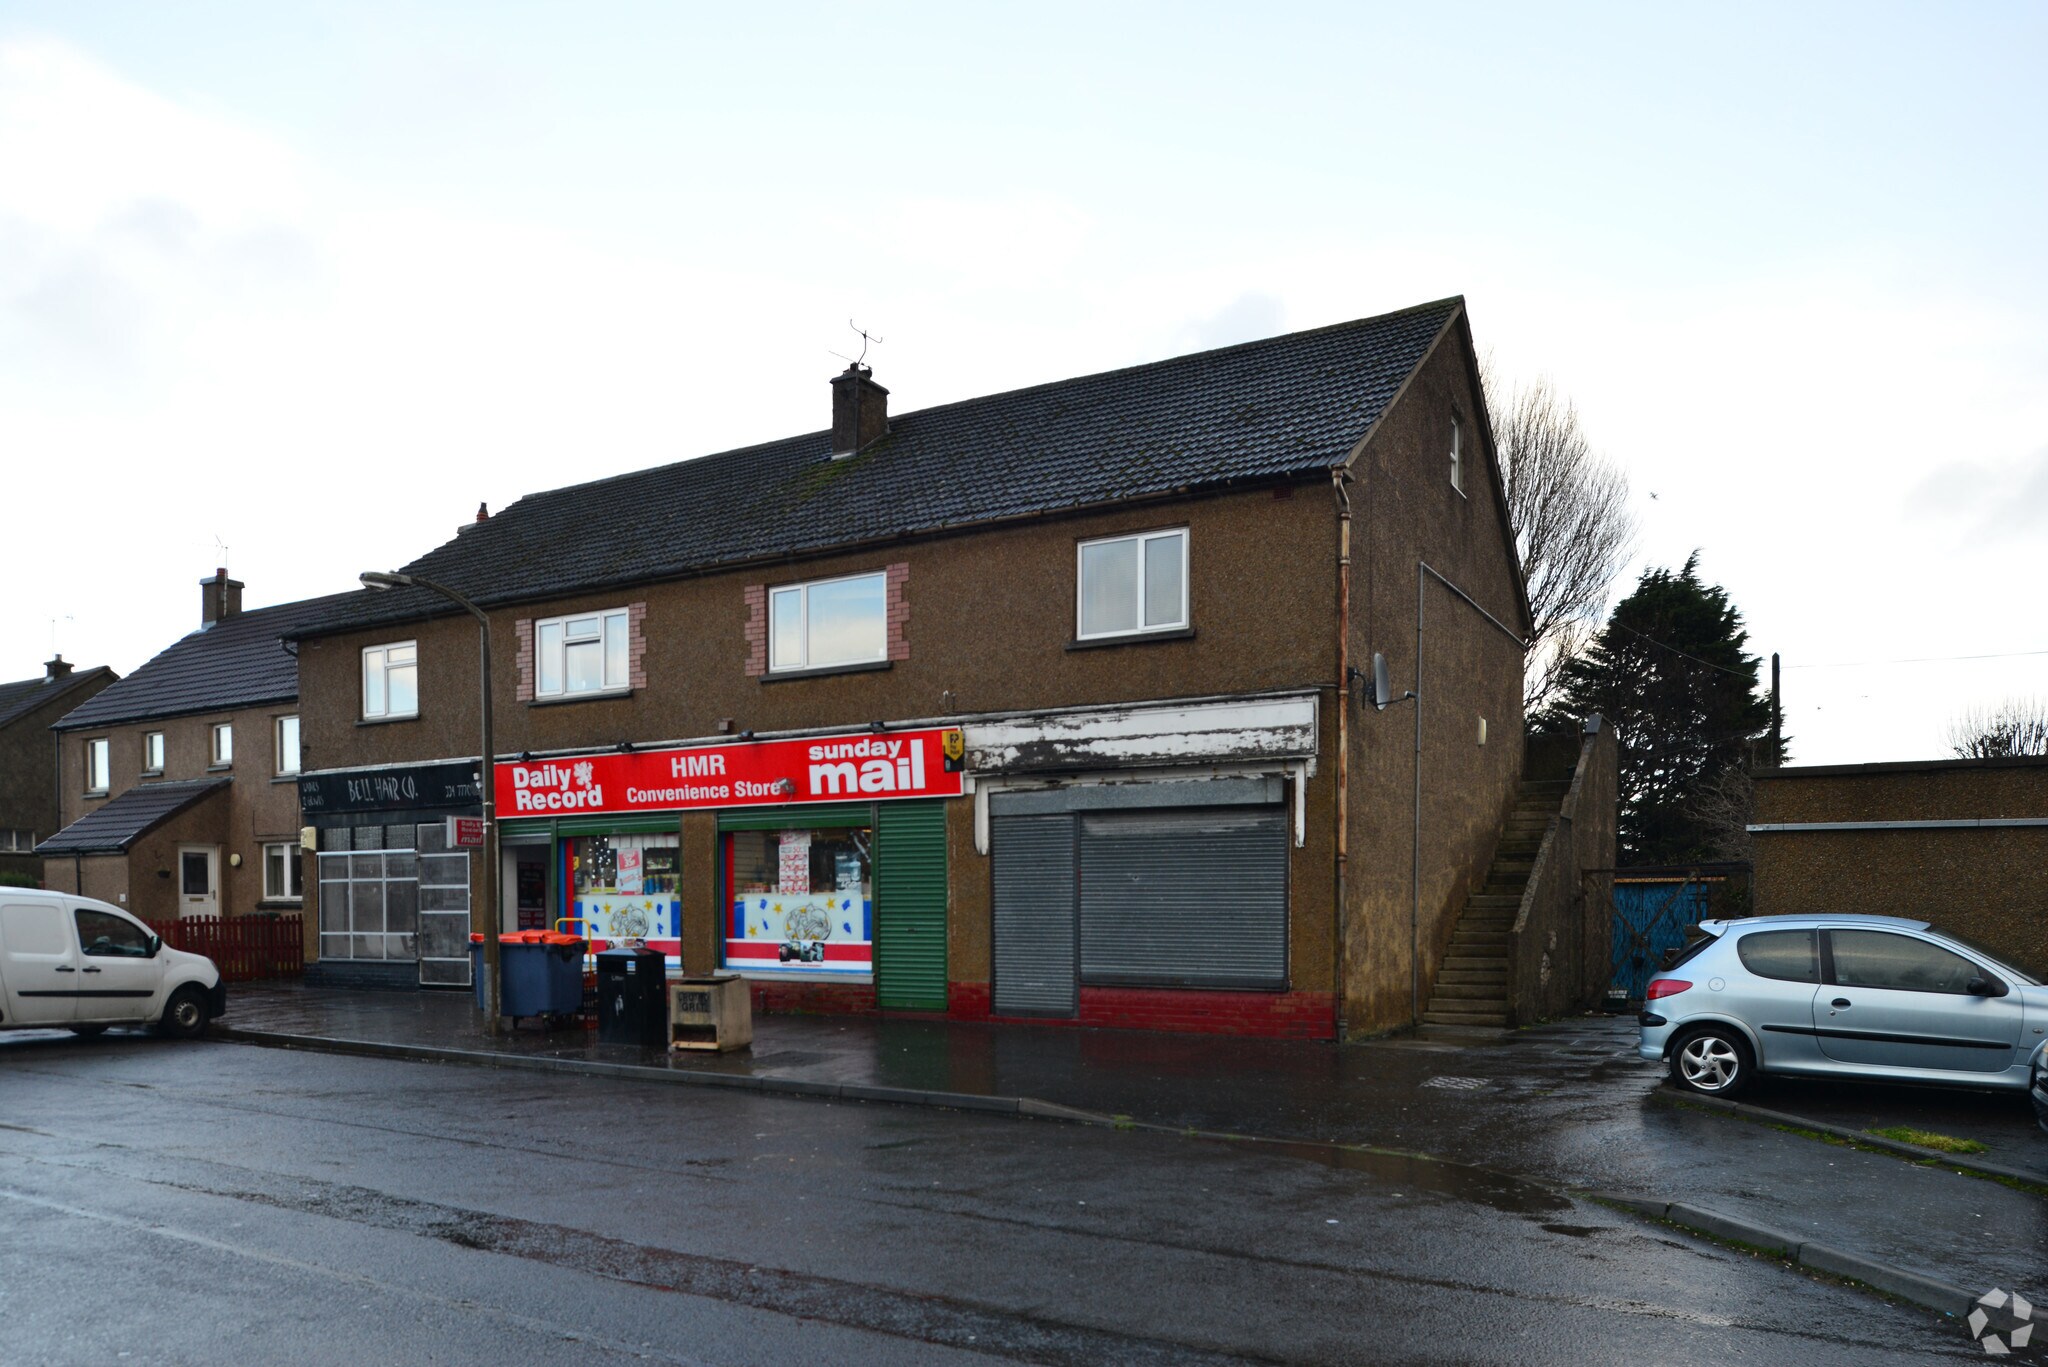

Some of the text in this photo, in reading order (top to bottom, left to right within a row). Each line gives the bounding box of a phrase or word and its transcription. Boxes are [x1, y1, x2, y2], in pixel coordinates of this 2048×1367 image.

[808, 738, 902, 761] sunday
[512, 764, 571, 791] Daily
[671, 754, 726, 778] HMR
[808, 738, 926, 795] mail
[347, 778, 375, 803] BELL
[515, 784, 603, 811] Record
[626, 780, 781, 803] Convenience Store
[460, 834, 483, 844] mail
